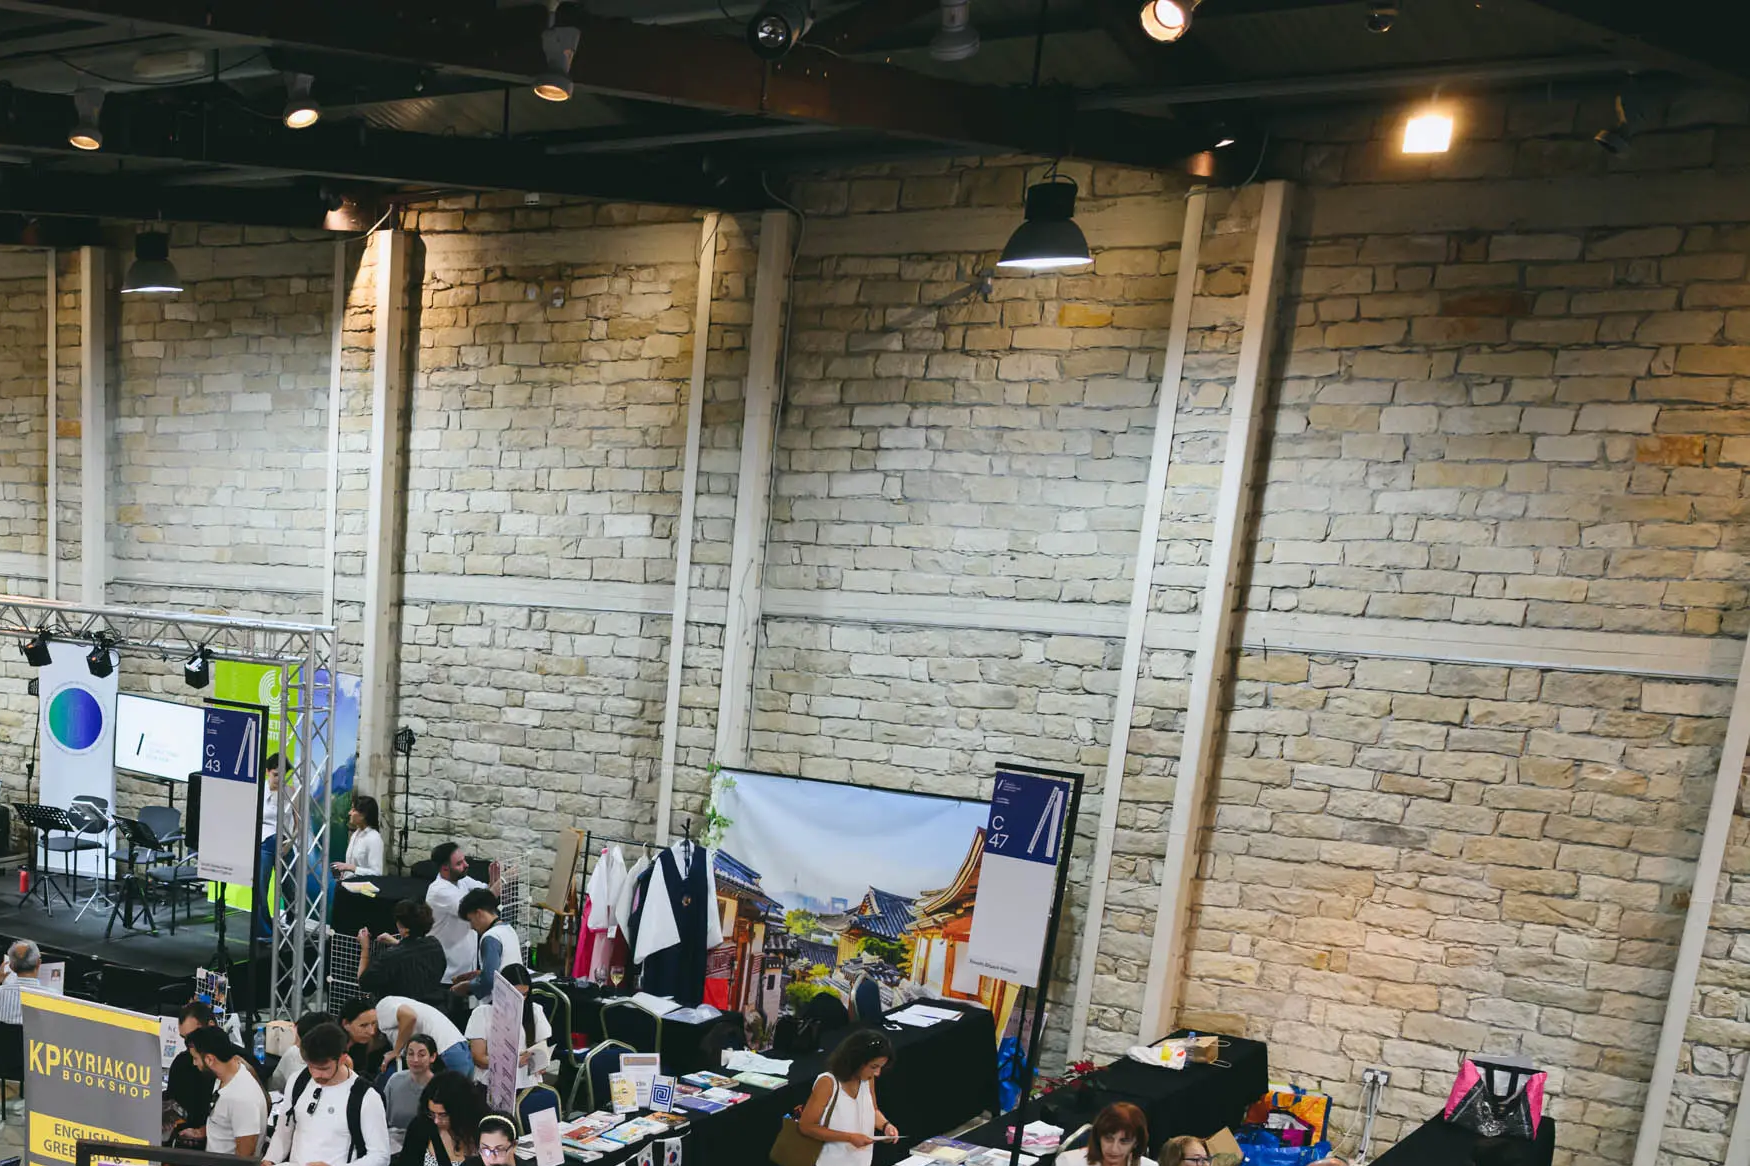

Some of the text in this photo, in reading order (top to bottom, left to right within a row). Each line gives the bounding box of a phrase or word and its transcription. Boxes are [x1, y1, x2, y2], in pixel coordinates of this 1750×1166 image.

[206, 744, 216, 757] C
[205, 759, 221, 773] 43
[991, 815, 1005, 831] C
[988, 833, 1009, 849] 47
[29, 1039, 151, 1086] KP KYRIAKOU
[62, 1070, 151, 1099] BOOKSHOP
[43, 1139, 76, 1158] GREE
